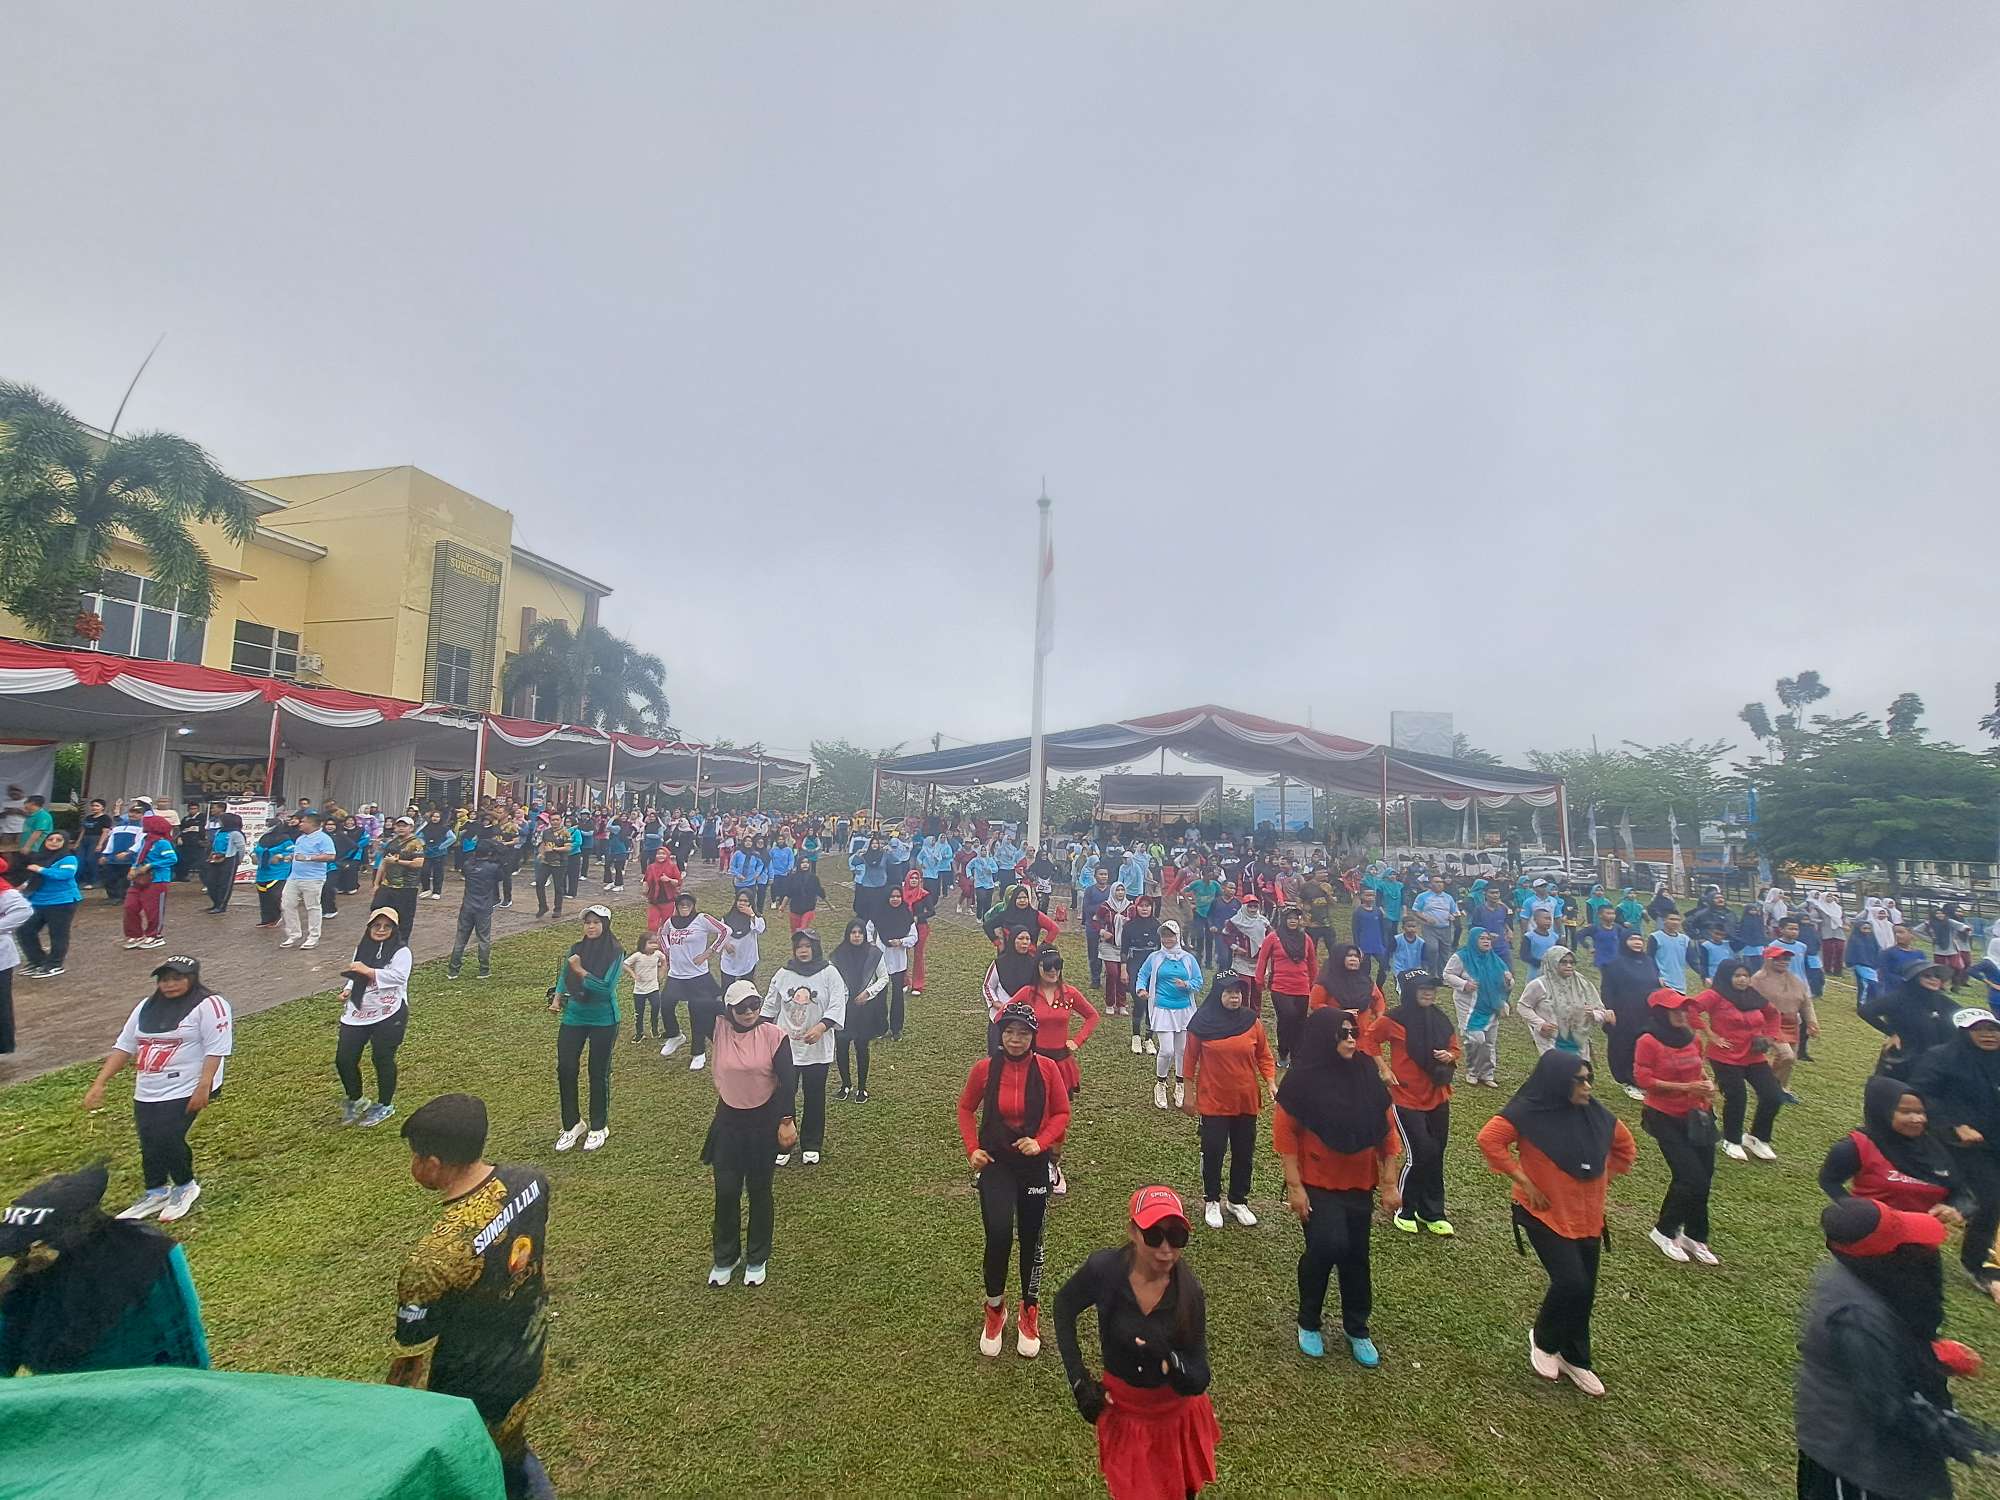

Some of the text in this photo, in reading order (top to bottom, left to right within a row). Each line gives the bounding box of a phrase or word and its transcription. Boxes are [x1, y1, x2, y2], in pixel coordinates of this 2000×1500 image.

[184, 762, 267, 782] MOCA
[203, 782, 264, 793] FLORIST
[473, 1202, 514, 1255] SUNGAI
